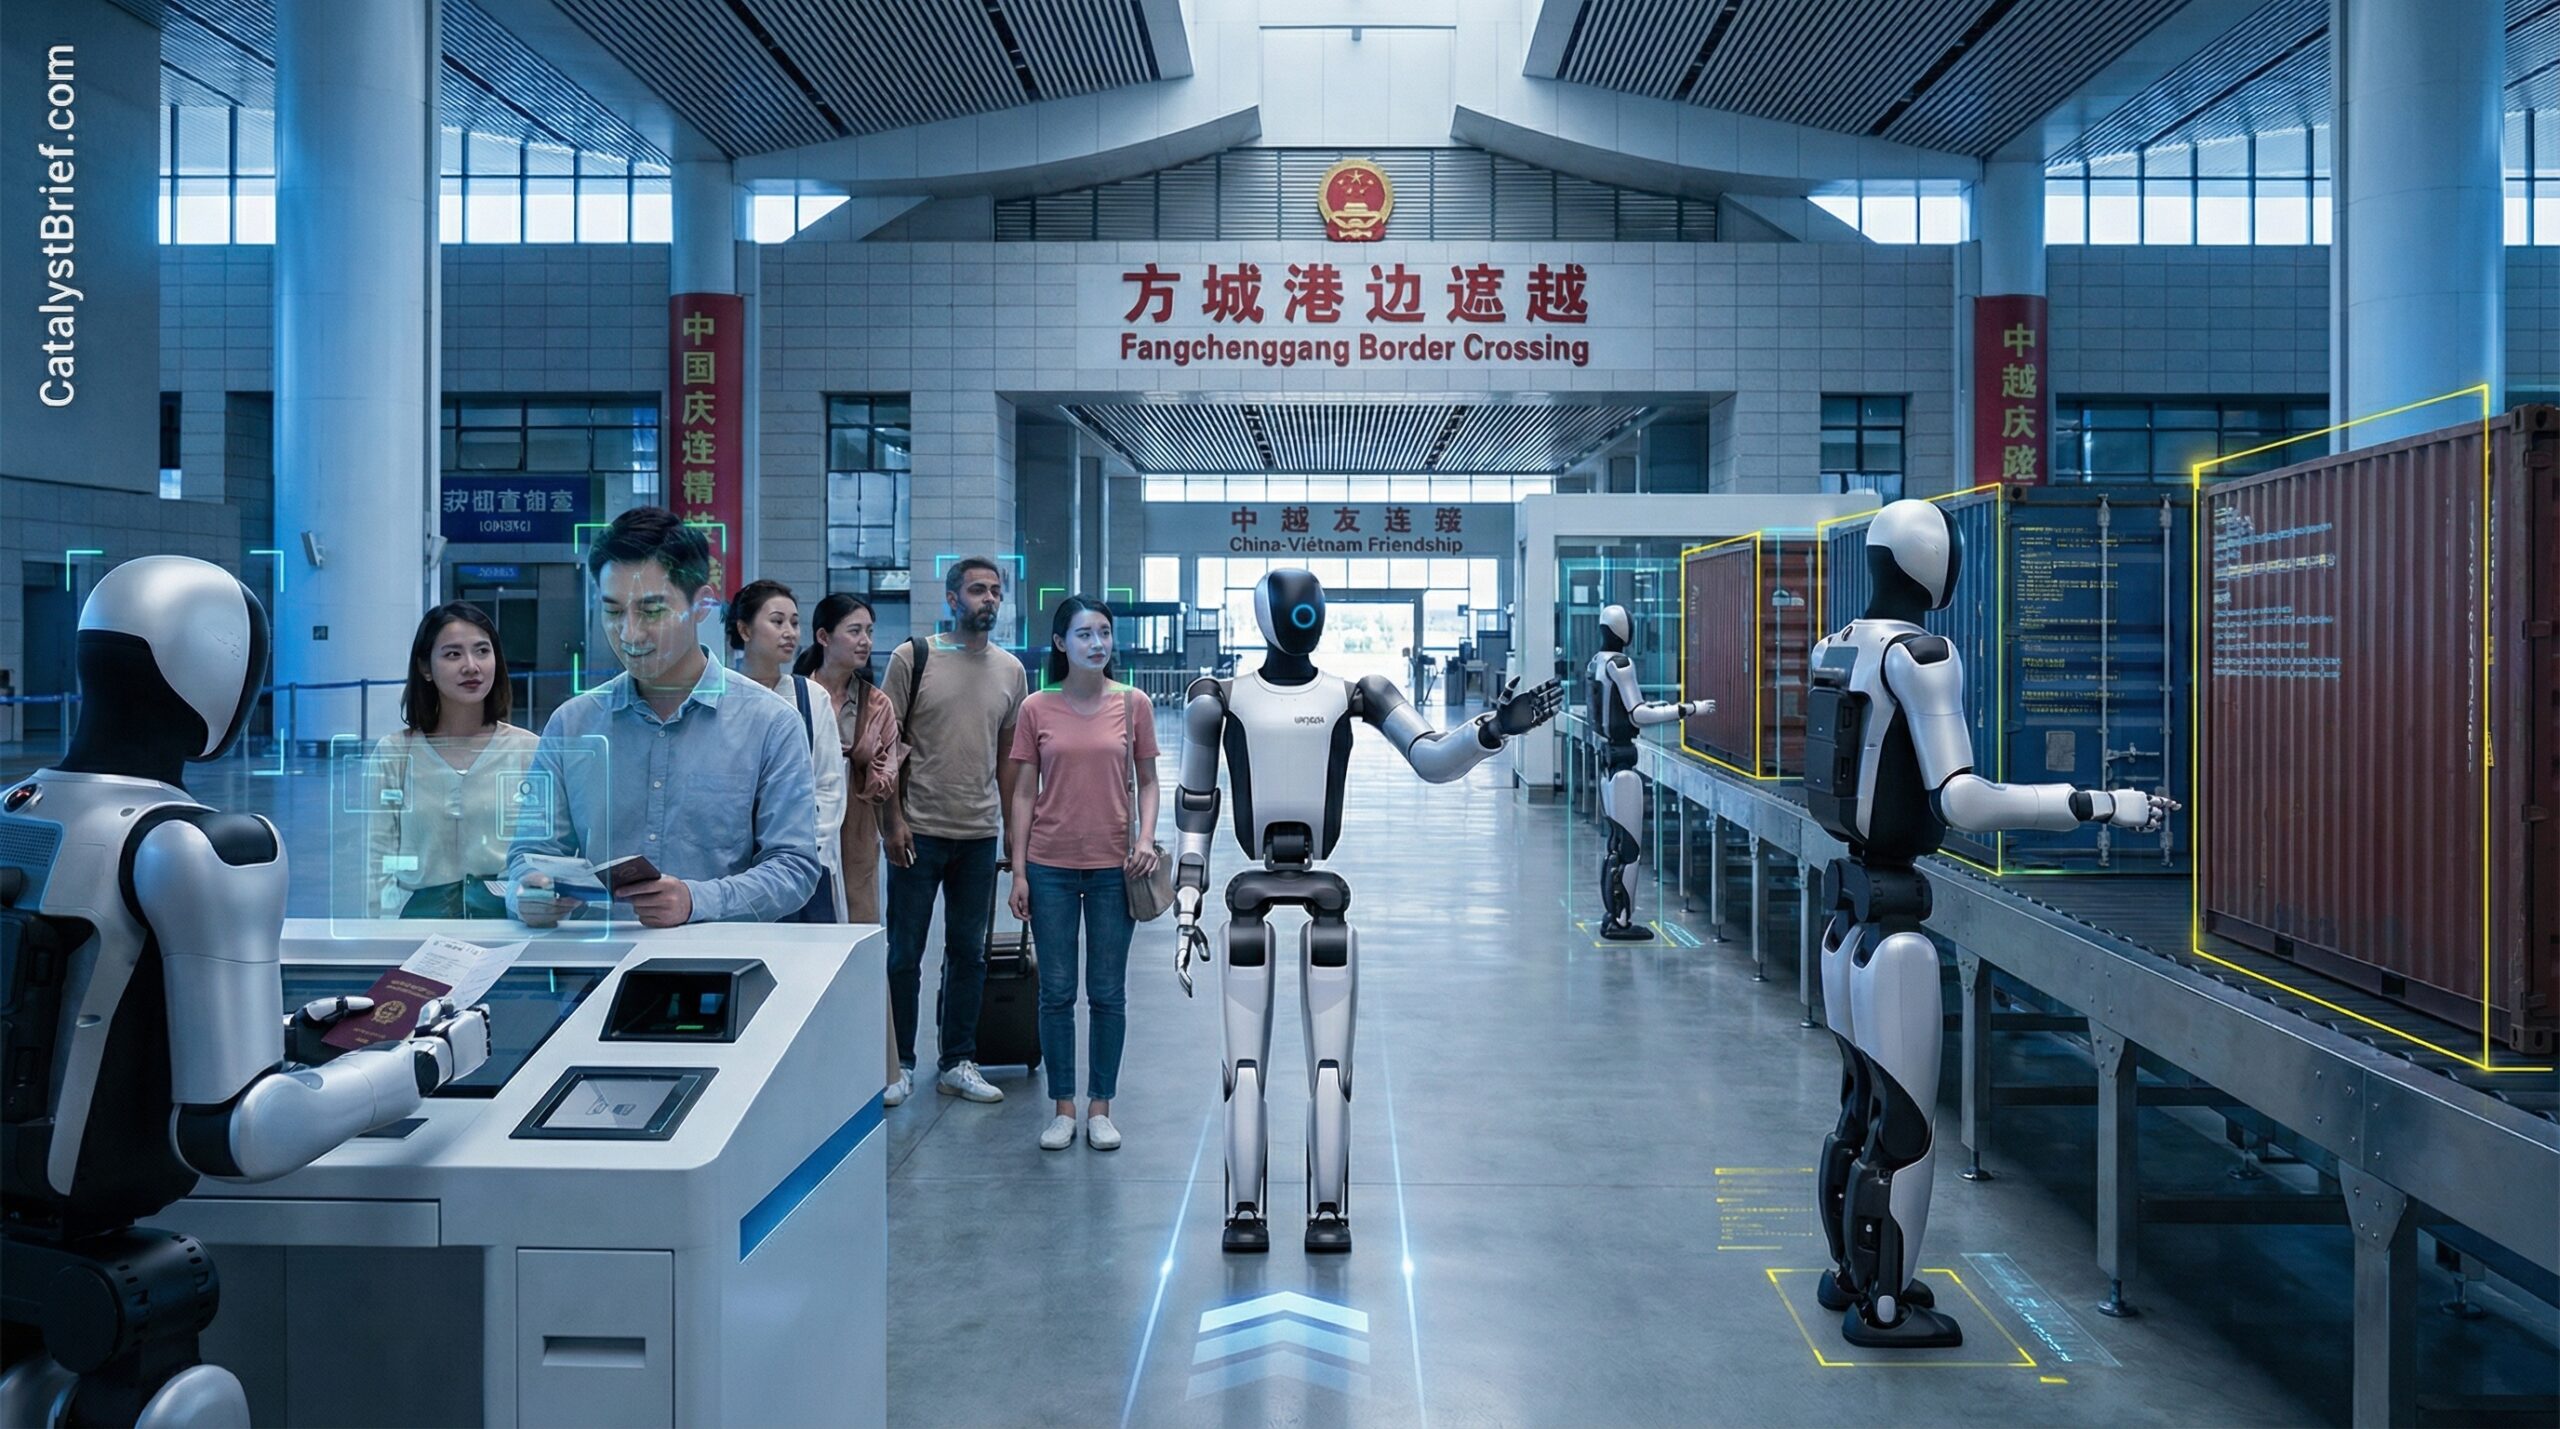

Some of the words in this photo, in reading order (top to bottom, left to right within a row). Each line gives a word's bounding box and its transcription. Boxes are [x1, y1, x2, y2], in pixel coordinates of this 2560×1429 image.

[1120, 333, 1350, 366] Fangchenggang
[1359, 333, 1456, 361] Border
[1464, 333, 1590, 367] Crossing
[1368, 536, 1463, 556] Friendship
